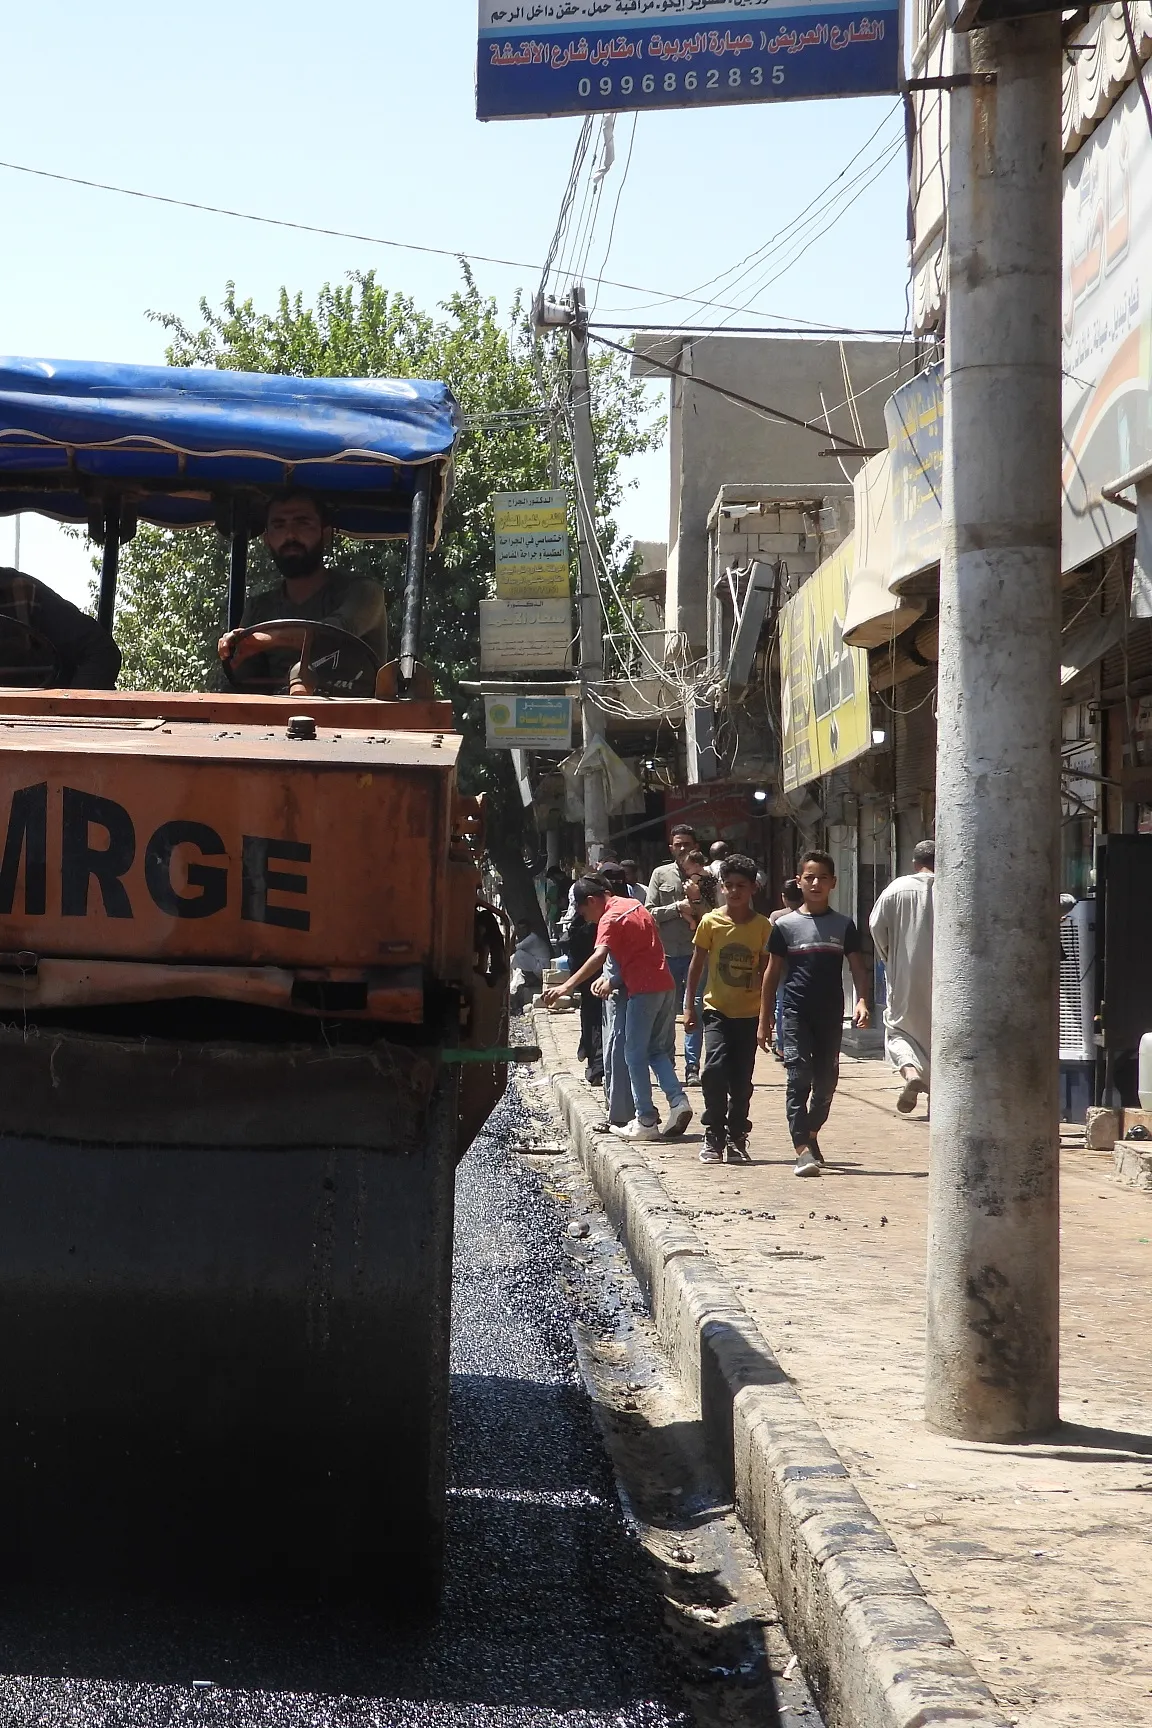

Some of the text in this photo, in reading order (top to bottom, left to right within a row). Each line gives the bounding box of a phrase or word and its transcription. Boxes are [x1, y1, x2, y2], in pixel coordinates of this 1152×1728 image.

[490, 6, 525, 23] الرحم
[526, 3, 555, 21] داخل
[767, 25, 829, 54] العريض
[829, 17, 885, 50] الشارع
[589, 36, 635, 66] مقابل
[647, 32, 708, 62] البربوت
[709, 29, 754, 57] عبارة
[489, 40, 550, 66] الأقمشة
[550, 37, 590, 70] شارع
[577, 64, 786, 97] 0996862835
[507, 496, 554, 508] الدكتور الجراح
[499, 534, 564, 548] اختصاصي في الجراحة
[499, 550, 519, 561] المفاصل
[519, 549, 538, 560] جراحة
[542, 548, 565, 560] العظمية
[506, 600, 544, 609] الدكتورة
[521, 698, 563, 711] مخبر
